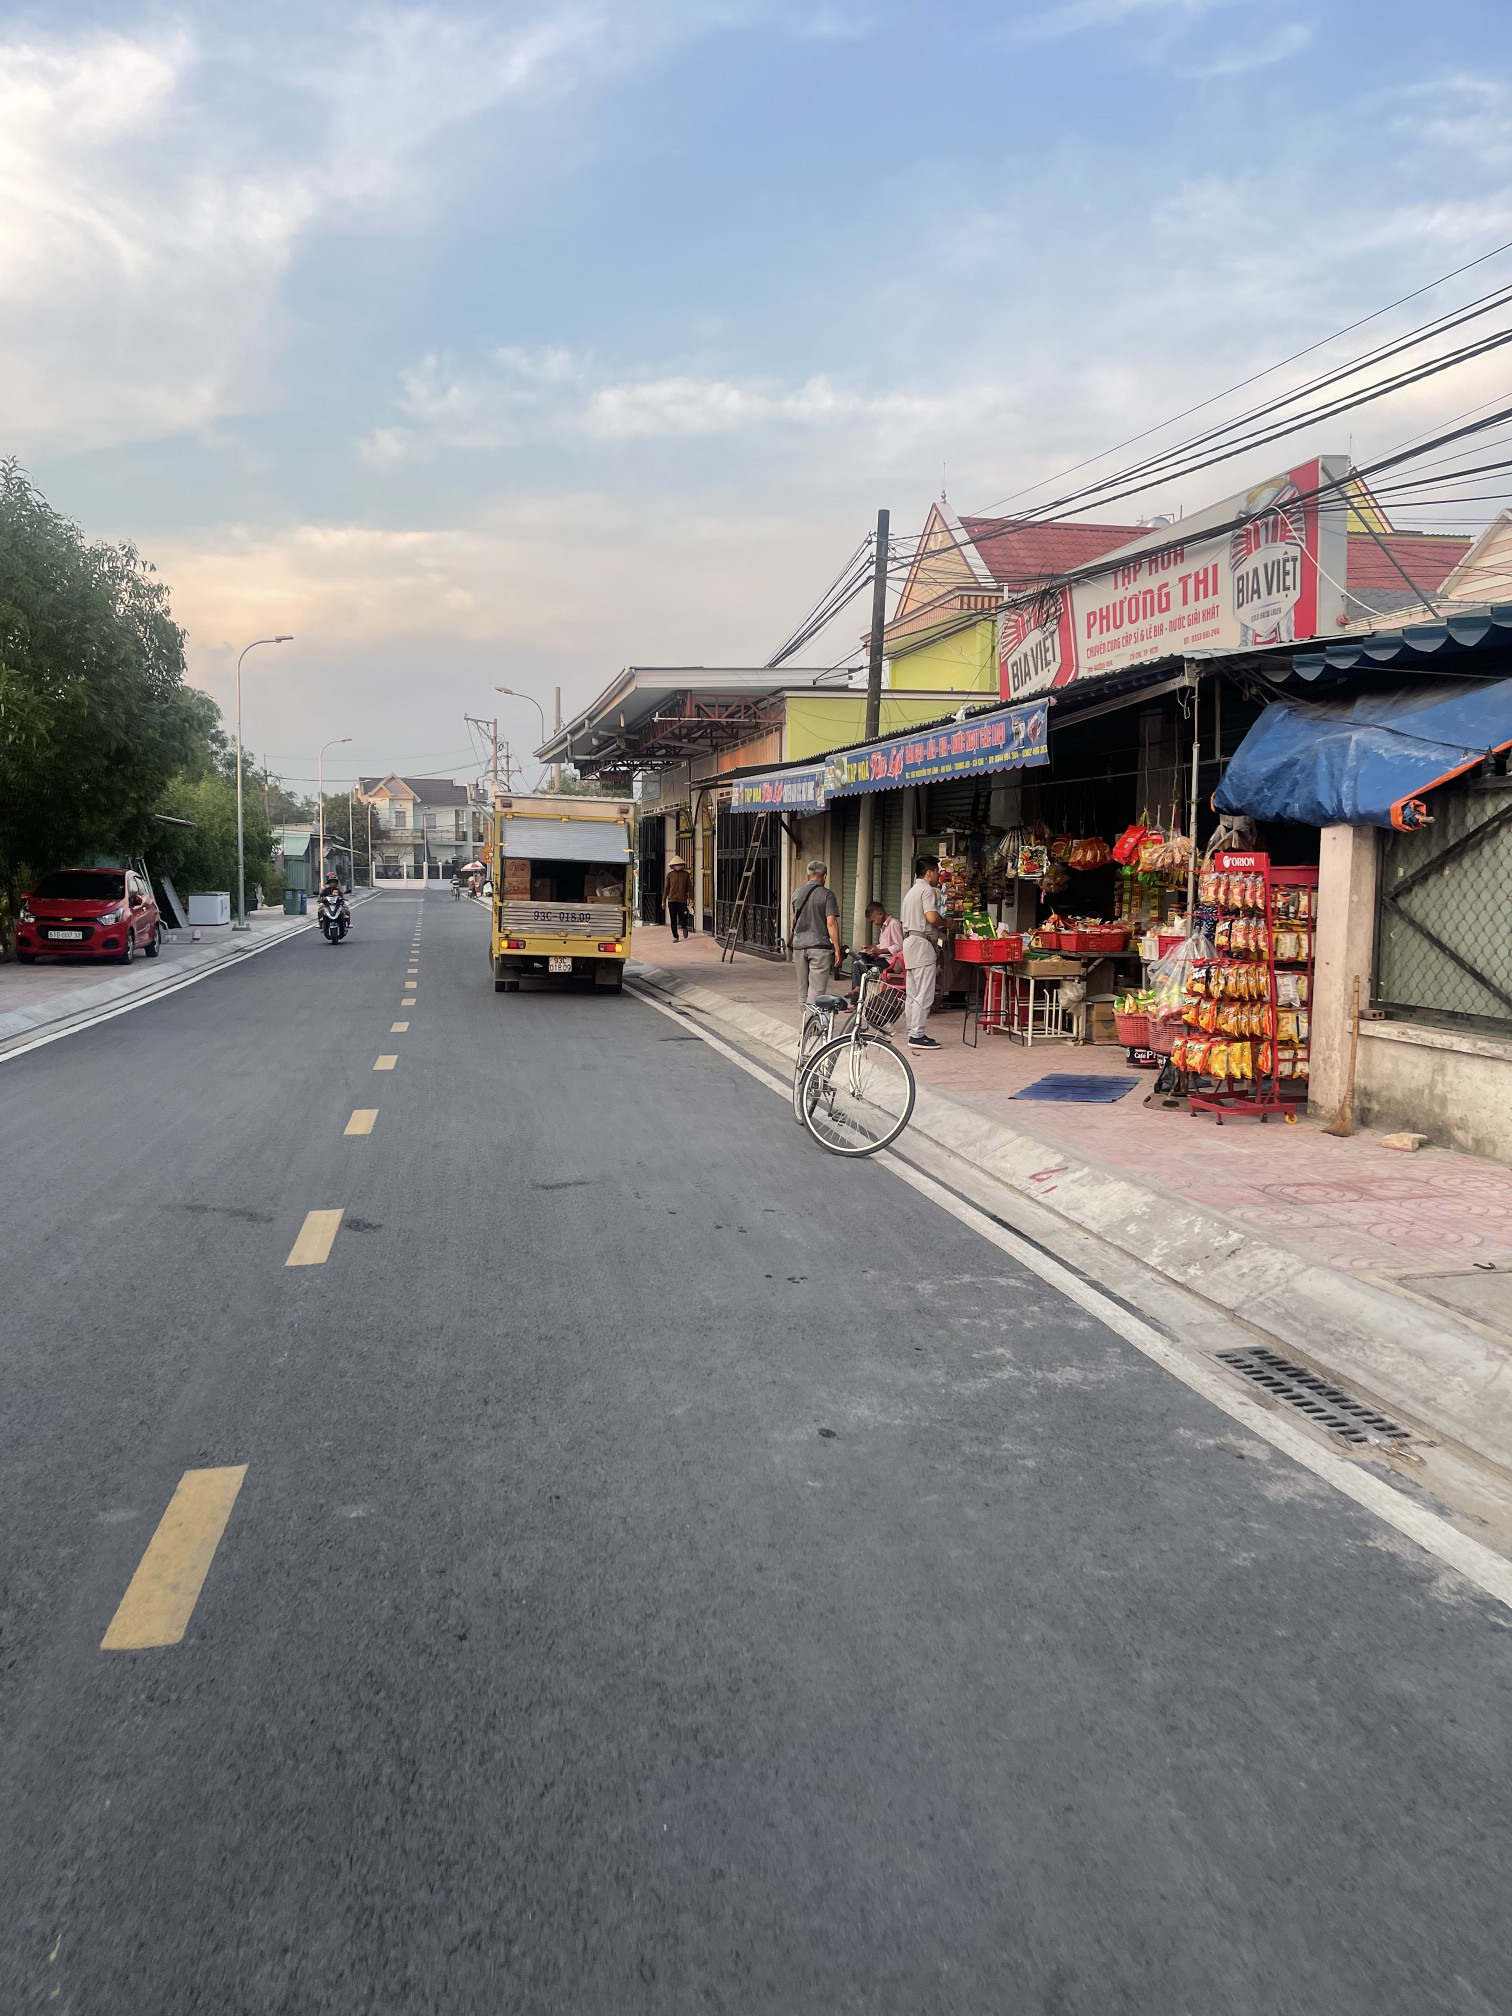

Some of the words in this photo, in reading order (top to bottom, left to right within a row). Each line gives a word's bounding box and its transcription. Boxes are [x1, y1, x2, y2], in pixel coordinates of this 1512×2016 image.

[1086, 582, 1171, 640] PHƯƠNG
[1178, 563, 1219, 606] THI
[1236, 566, 1262, 610] BIA
[1263, 550, 1299, 599] VIỆT
[1086, 641, 1107, 659] CHUYÊN
[1106, 637, 1121, 652] CUNG
[1153, 622, 1164, 638] BIA
[1202, 603, 1220, 623] KHÁT
[1010, 652, 1032, 693] BIA
[1231, 857, 1255, 867] ORION
